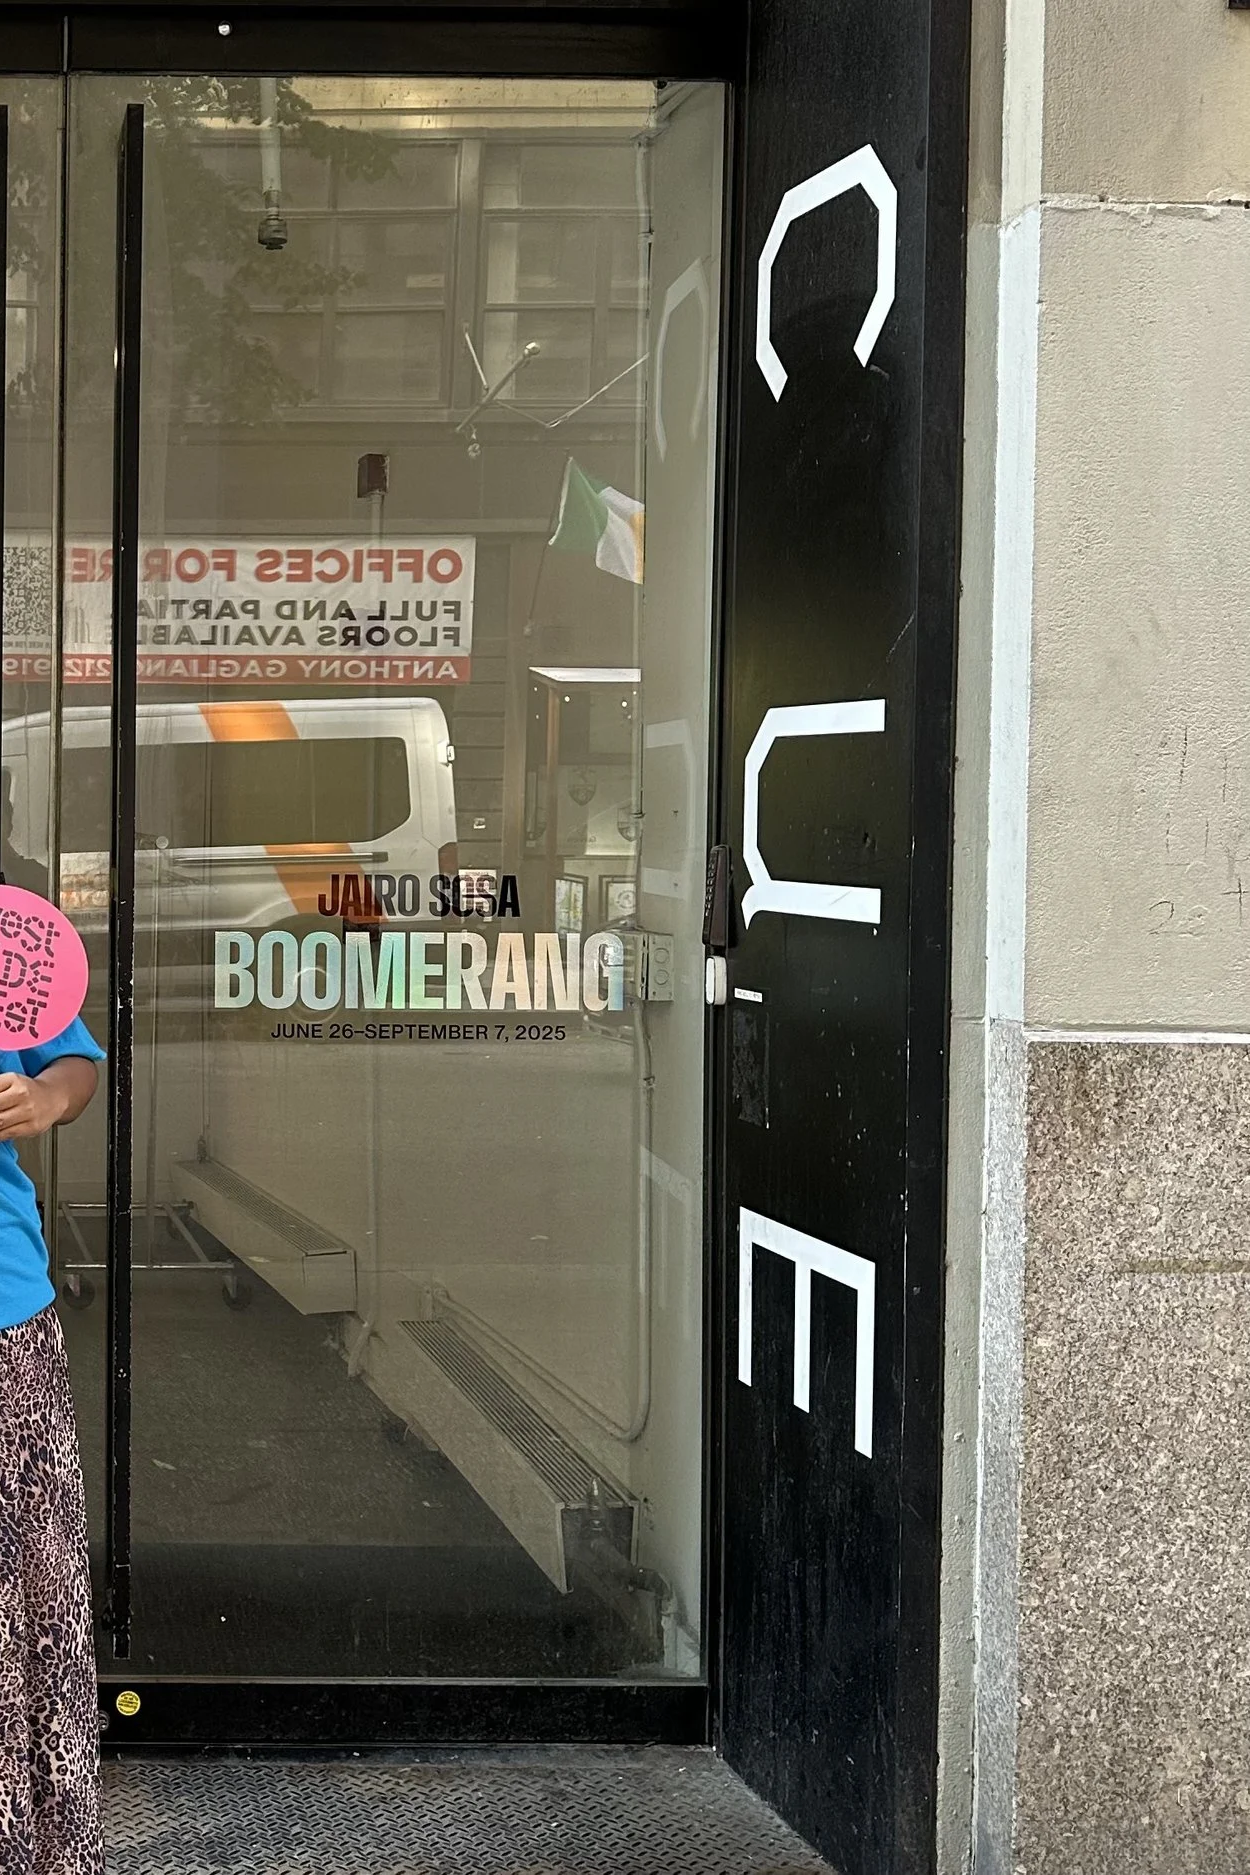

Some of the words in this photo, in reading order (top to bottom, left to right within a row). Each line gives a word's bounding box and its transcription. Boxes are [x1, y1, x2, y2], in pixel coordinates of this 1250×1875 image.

[318, 874, 419, 918] JAIRO
[429, 874, 521, 918] SOSA
[214, 931, 625, 1012] BOOMERANG
[270, 1023, 323, 1039] JUNE
[494, 1025, 510, 1042] 7,
[515, 1025, 566, 1041] 2025
